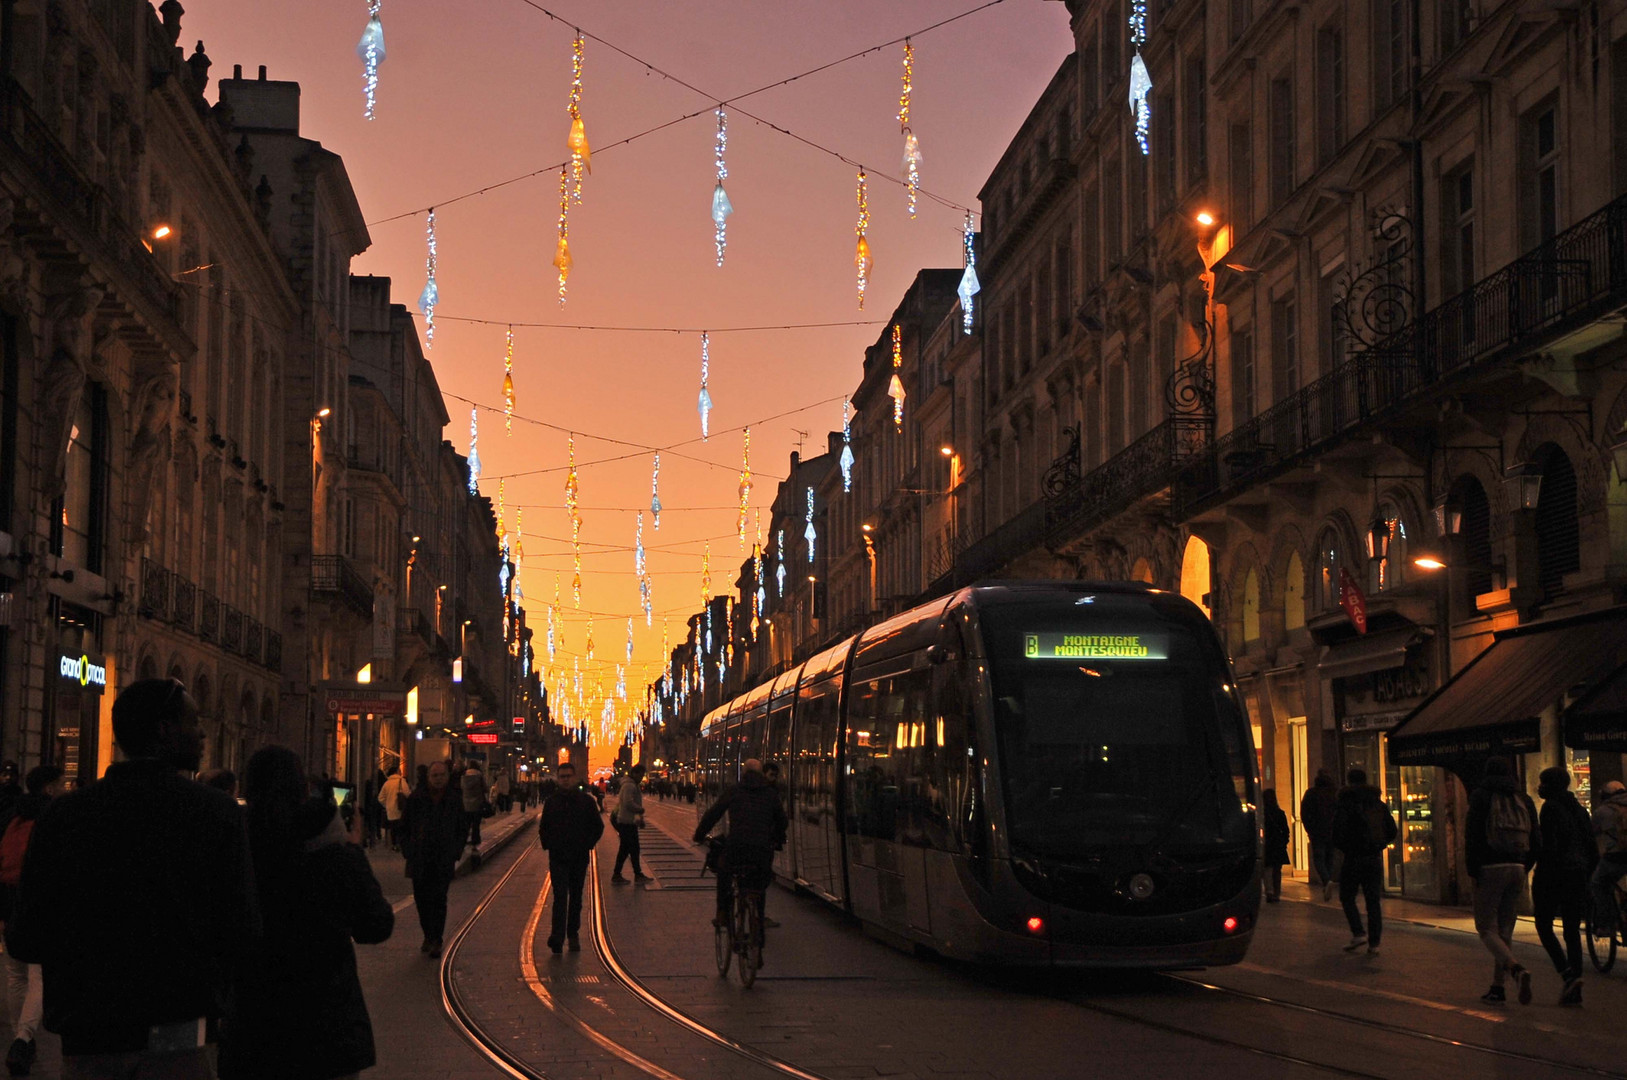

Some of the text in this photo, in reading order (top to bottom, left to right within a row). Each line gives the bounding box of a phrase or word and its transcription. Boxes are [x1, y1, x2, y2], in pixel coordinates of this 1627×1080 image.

[1343, 576, 1365, 625] TABAC
[1026, 636, 1038, 655] B
[1064, 635, 1140, 646] MONTAIGNE
[1054, 646, 1148, 657] MONTESQUIEU
